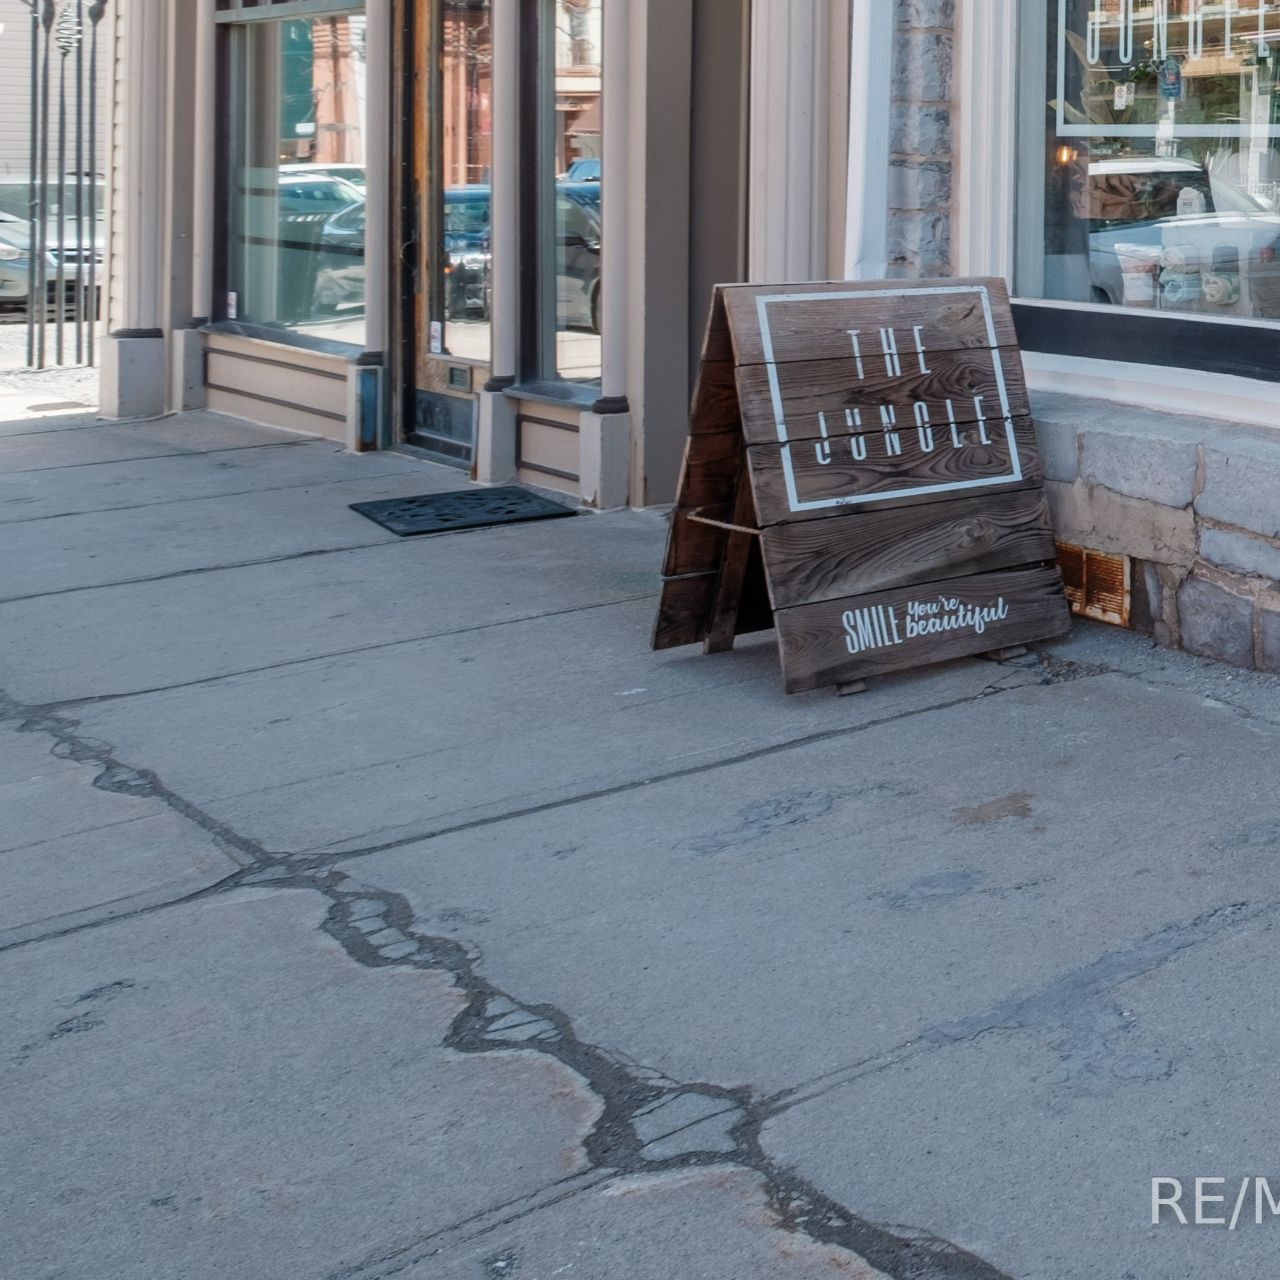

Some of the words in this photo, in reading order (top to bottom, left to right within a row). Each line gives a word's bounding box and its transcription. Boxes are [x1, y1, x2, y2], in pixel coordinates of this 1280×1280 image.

[846, 325, 931, 379] THE
[815, 396, 992, 465] JUNGLE
[842, 605, 903, 654] SMILE
[906, 596, 1008, 638] beautiful
